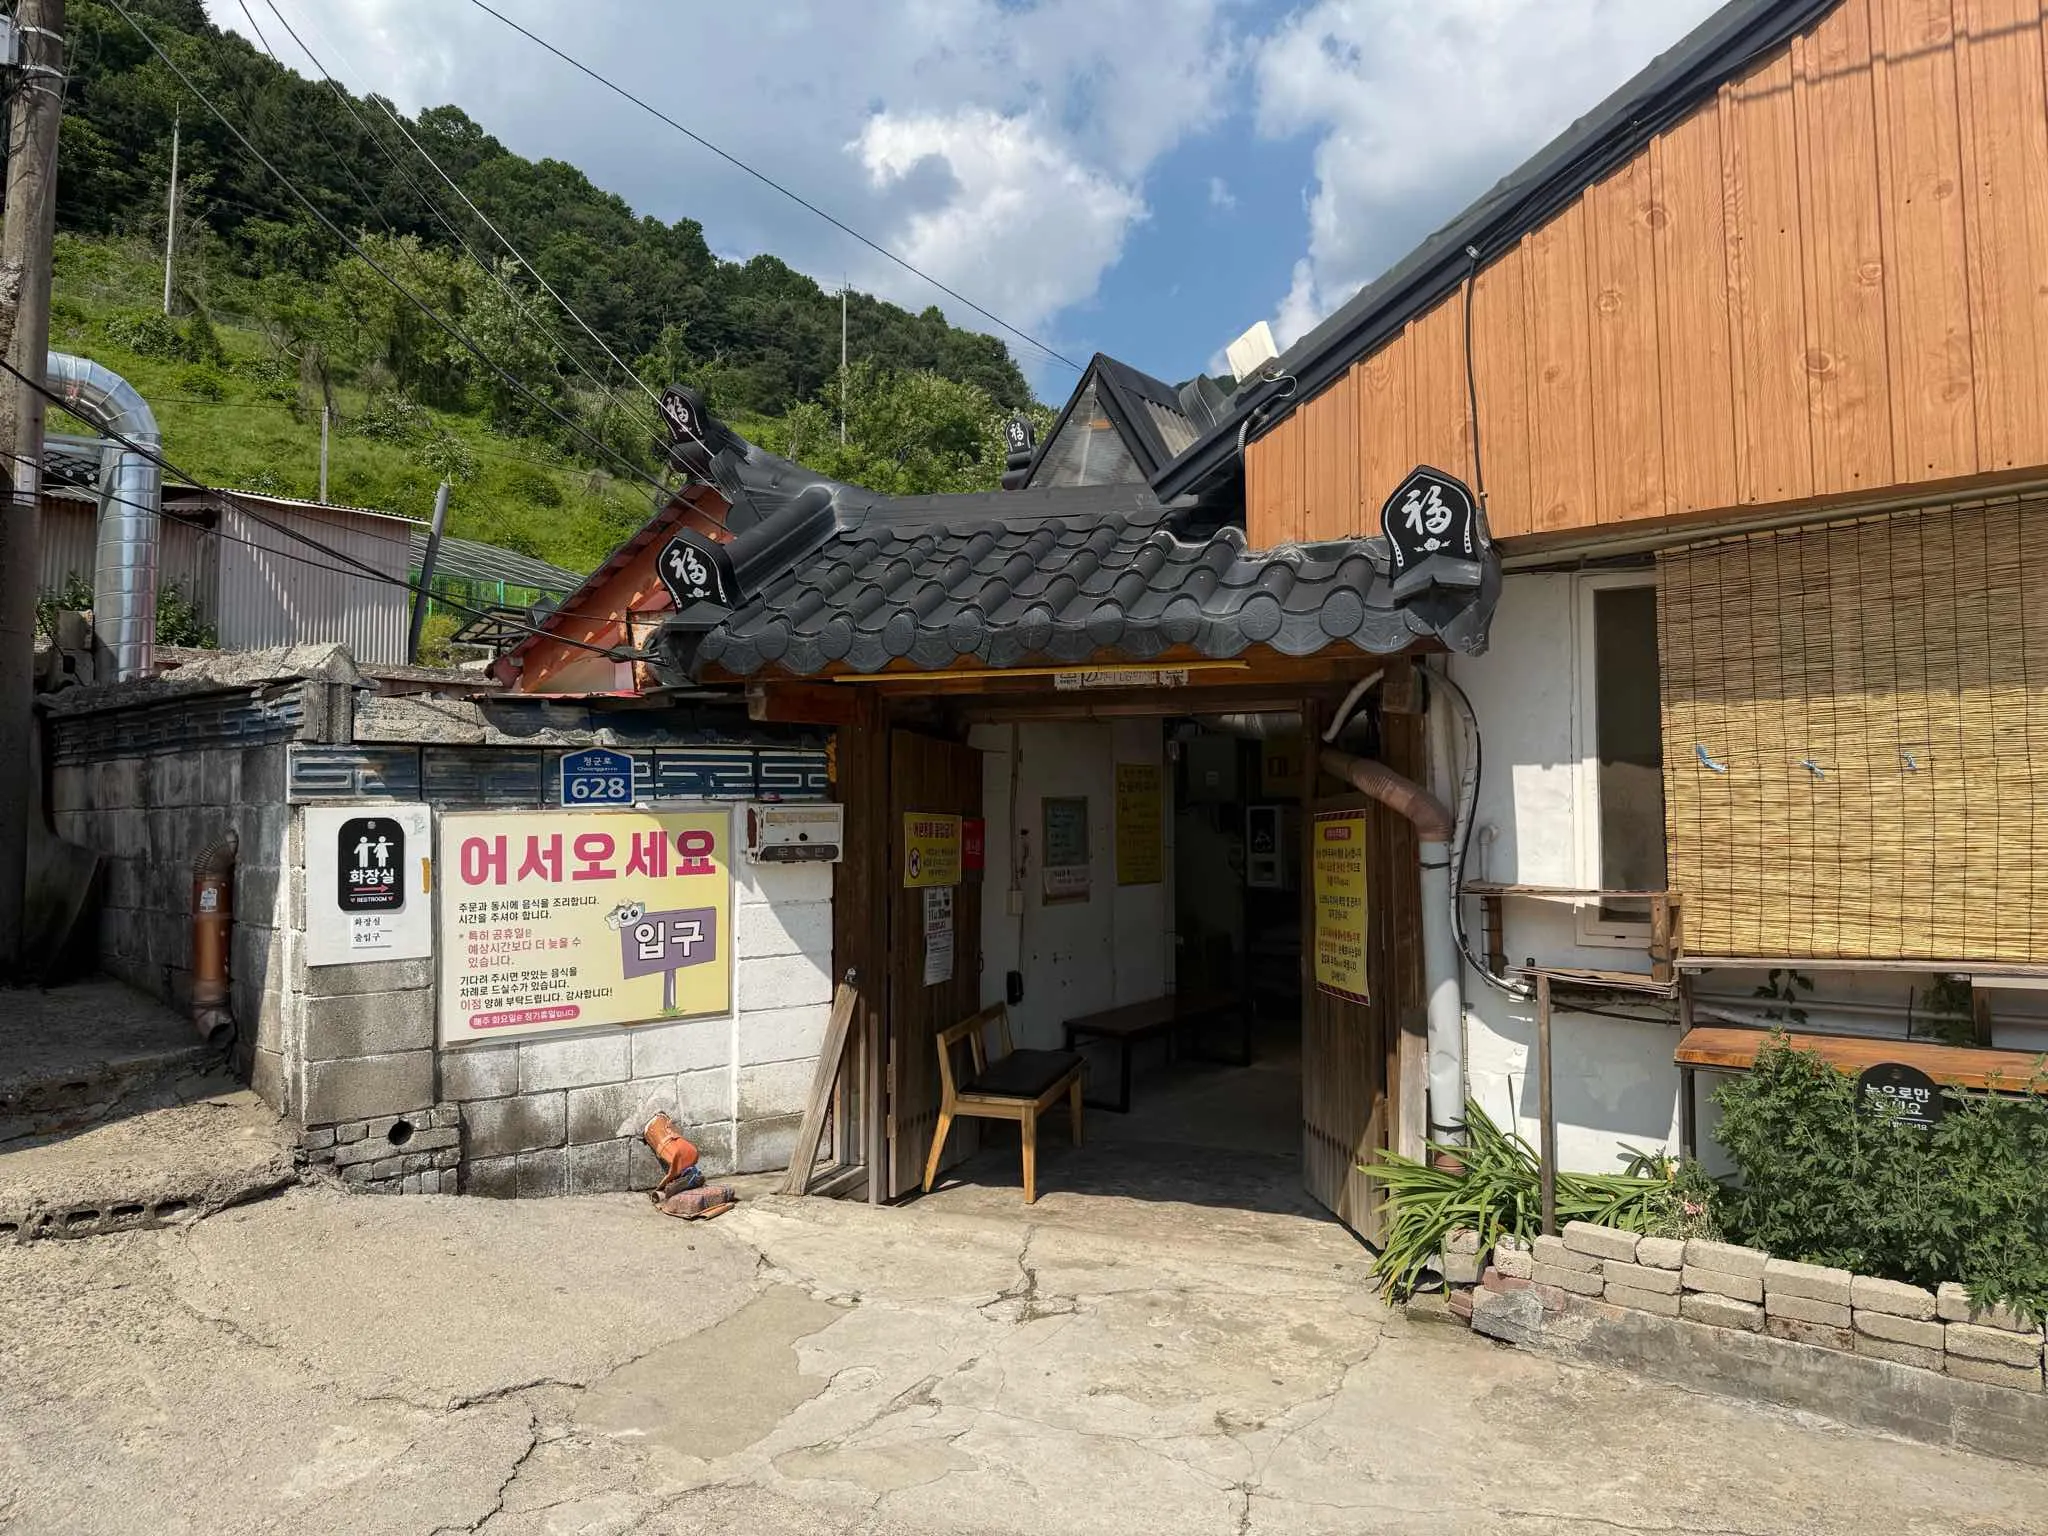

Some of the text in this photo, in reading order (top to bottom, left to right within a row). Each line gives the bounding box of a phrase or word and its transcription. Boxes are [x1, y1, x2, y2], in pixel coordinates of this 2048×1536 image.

[1010, 422, 1024, 441] 福
[1401, 485, 1452, 534] 福
[669, 547, 708, 585] 福
[572, 777, 625, 799] 628
[460, 830, 717, 885] 어서오세요
[349, 868, 394, 885] 화장실
[459, 896, 600, 912] 주문과 동시에 음식을 조리합니다.
[354, 917, 381, 926] 화장실
[459, 910, 551, 924] 시간을 주셔야 합니다.
[354, 933, 381, 943] 출입구
[469, 928, 531, 941] 특히 공휴일은
[634, 919, 705, 961] 입구
[468, 937, 581, 955] 예상시간보다 더 늦을 수
[468, 955, 515, 968] 있습니다.
[461, 967, 577, 985] 기다려 주시면 맛있는 음식을
[461, 986, 488, 998] 차례로
[531, 979, 569, 991] 있습니다.
[461, 988, 613, 1010] 이점 양해 부탁드립니다. 감사합니다!
[473, 1016, 490, 1026] 매주
